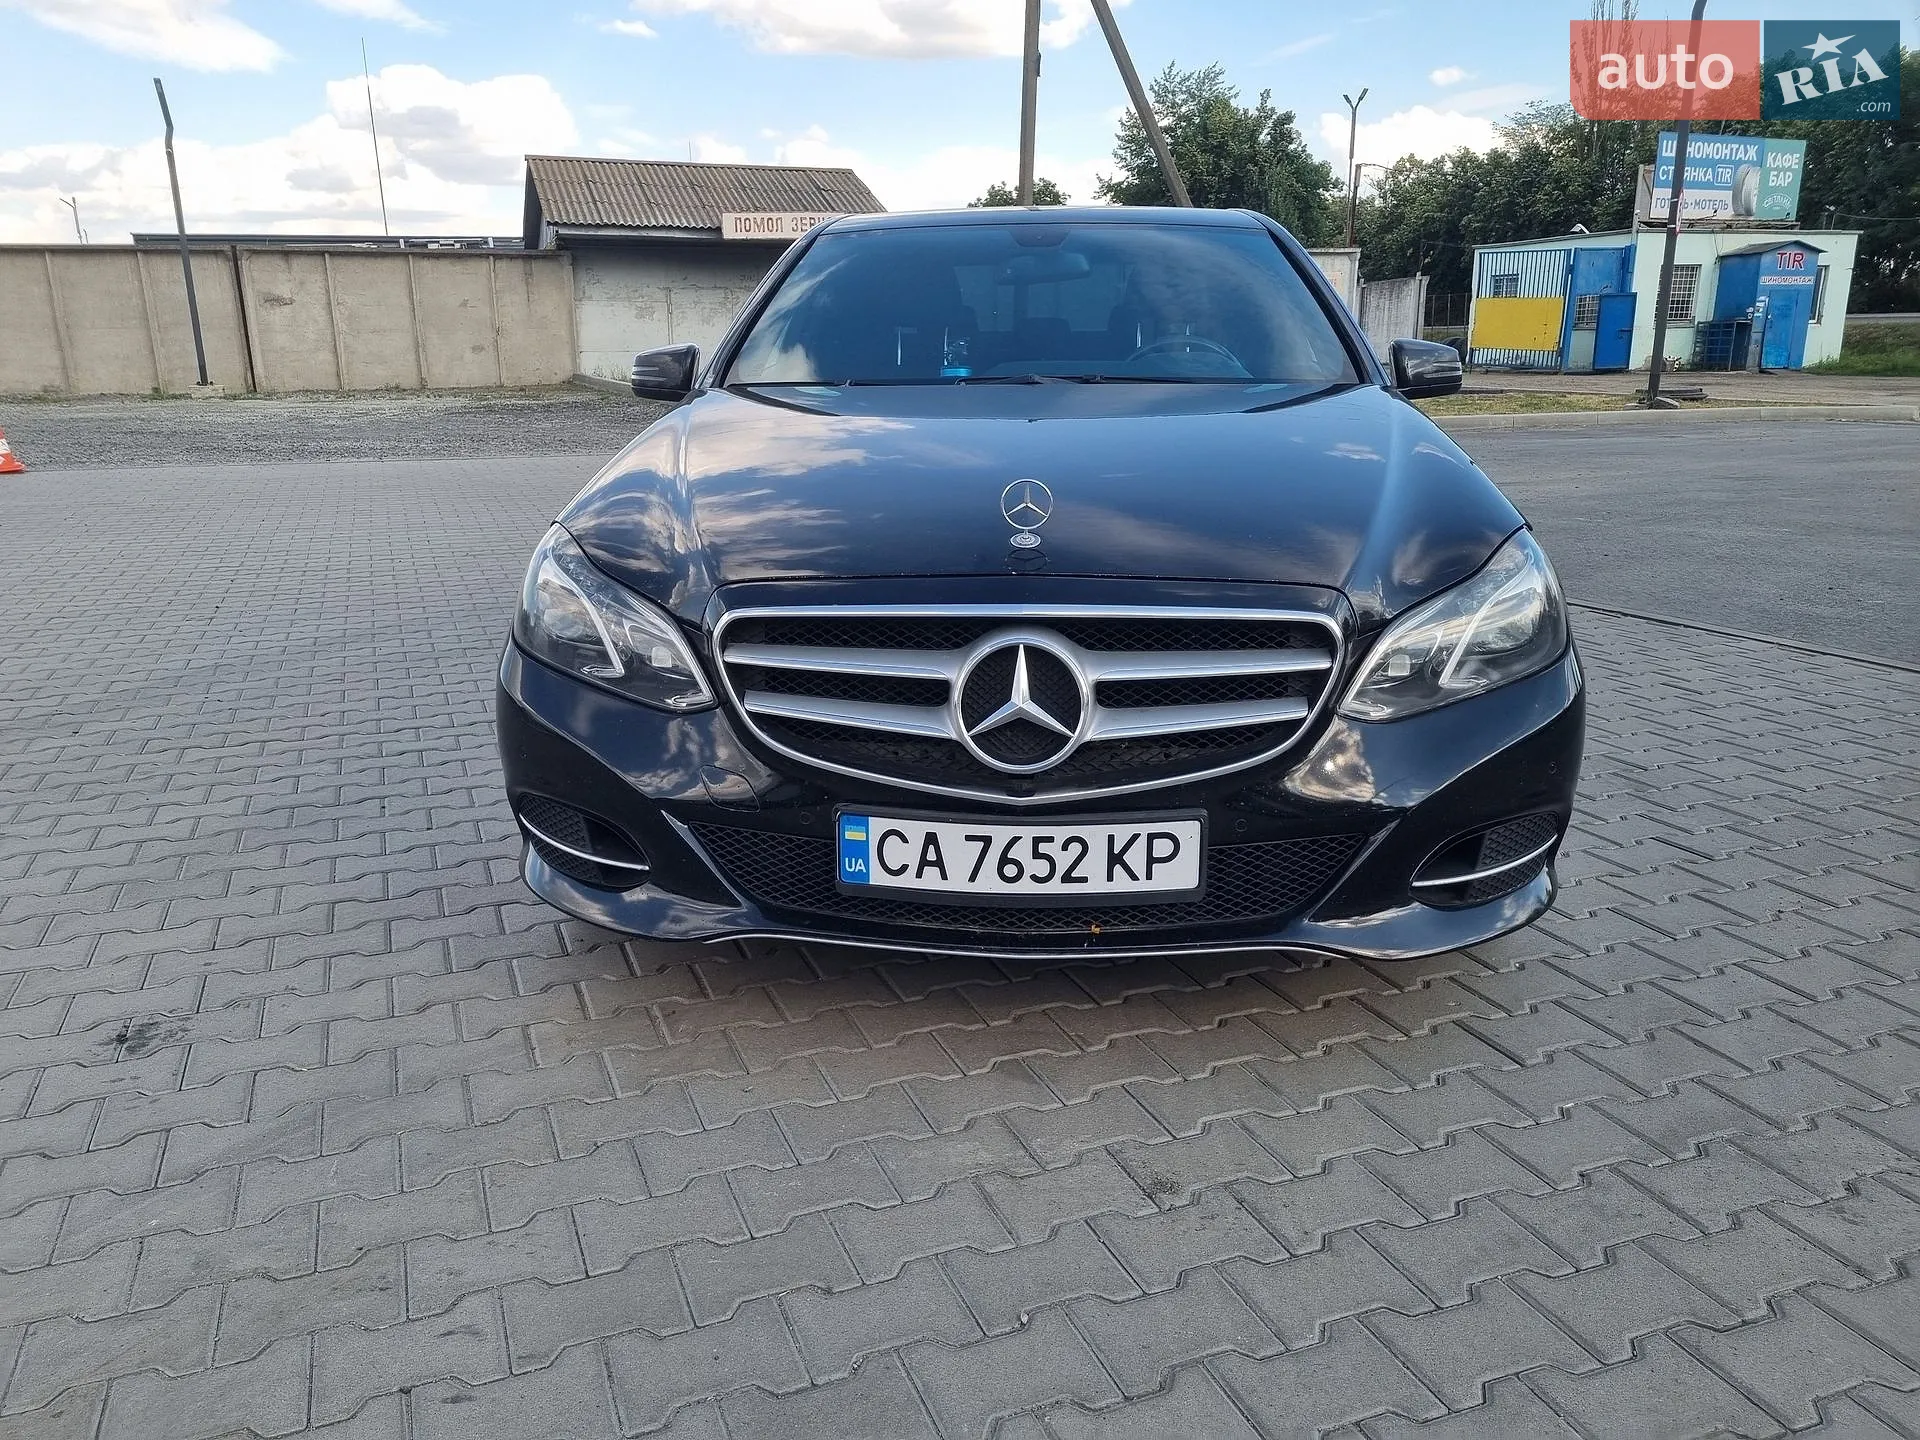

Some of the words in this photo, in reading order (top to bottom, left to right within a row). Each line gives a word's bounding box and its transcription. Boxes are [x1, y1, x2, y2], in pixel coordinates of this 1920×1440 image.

[1662, 140, 1759, 161] ШНОМОНТАЖ
[1766, 152, 1800, 169] КАФЕ
[1659, 165, 1713, 182] СТЯНКА
[1717, 168, 1732, 183] TIR
[1769, 172, 1793, 187] БАР
[734, 217, 784, 233] ПОМОЛ
[1776, 252, 1805, 270] TIR
[1761, 276, 1813, 284] ШИНОМОНТАЖ
[876, 828, 949, 881] CA
[964, 834, 1089, 884] 7652
[1106, 831, 1182, 882] KP
[845, 857, 867, 873] UA
